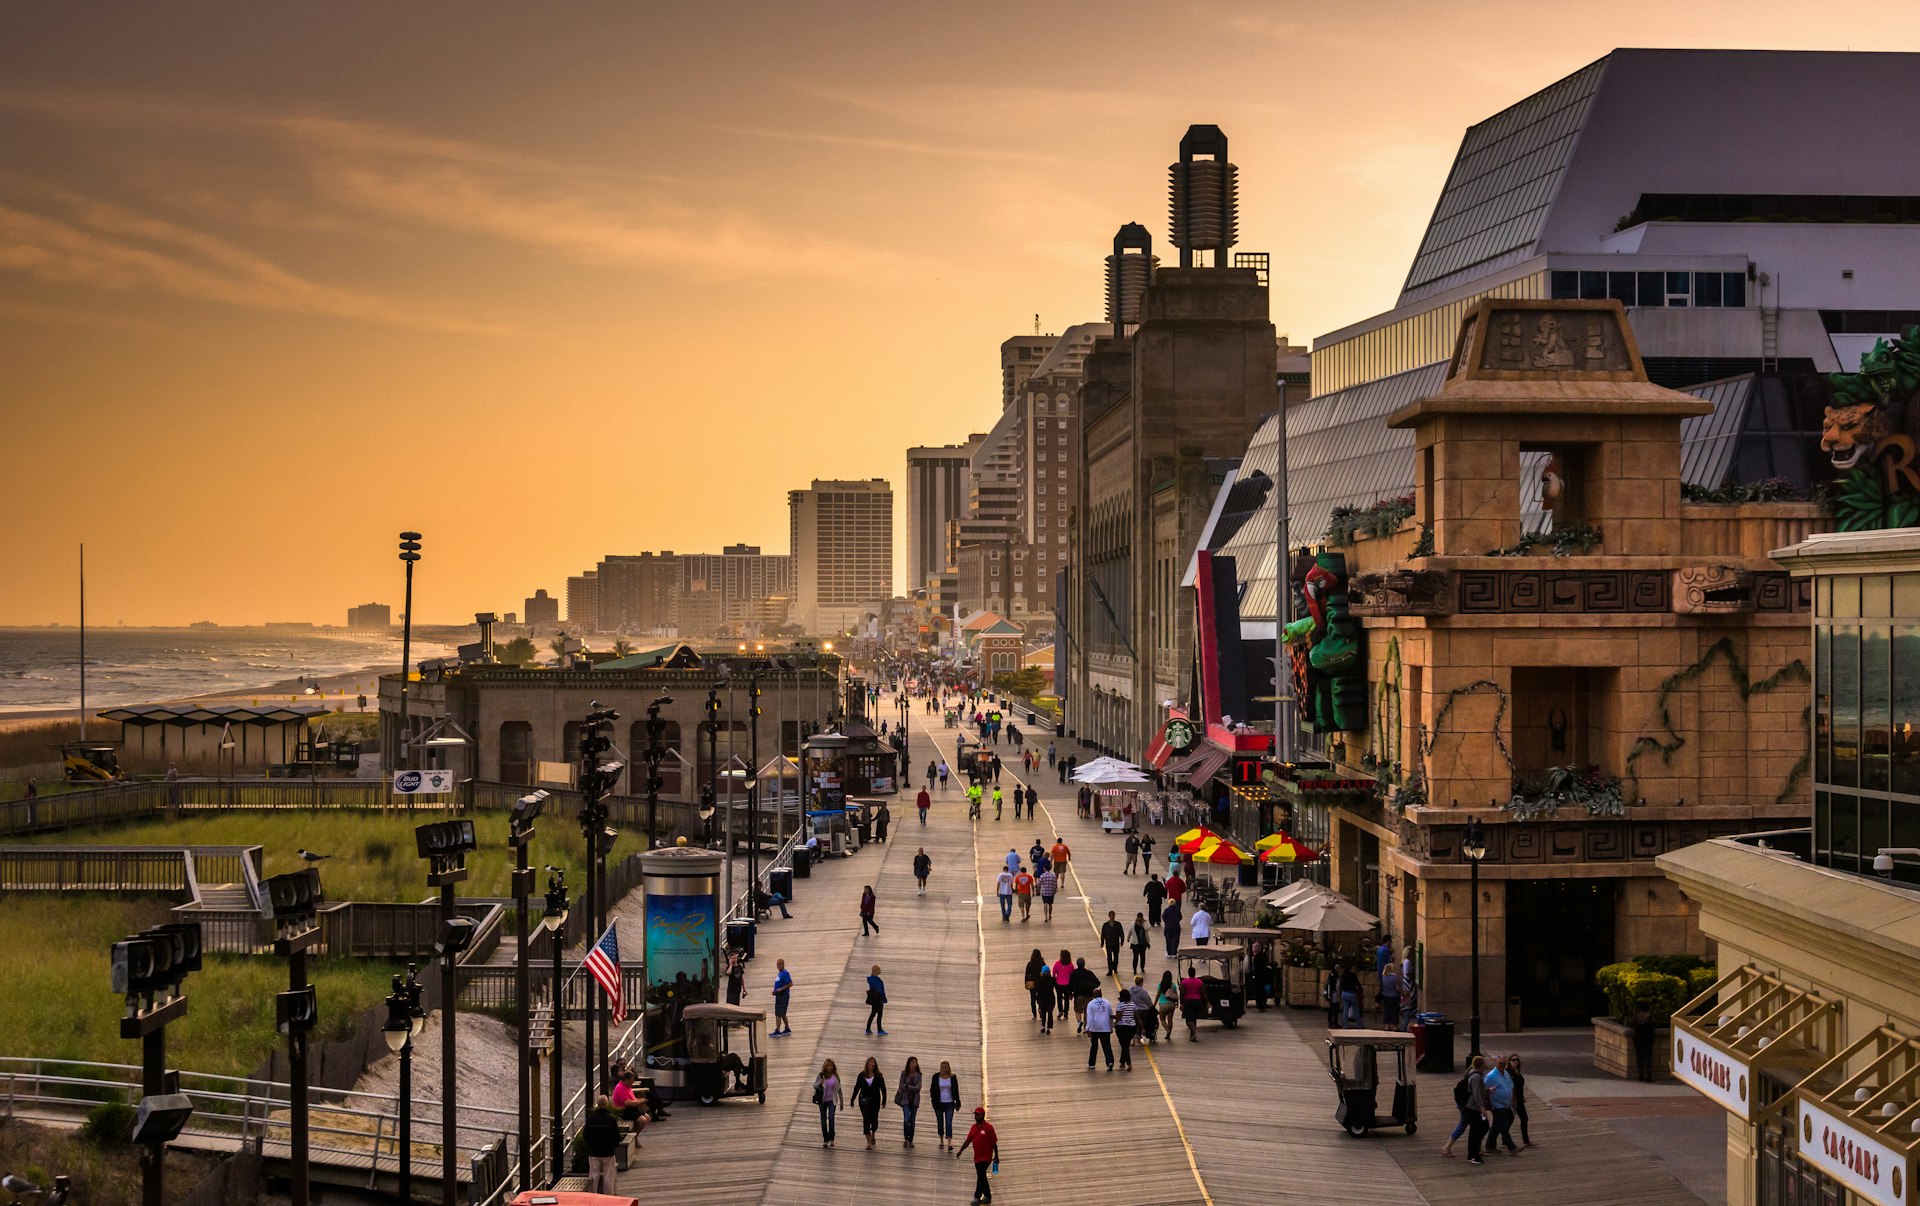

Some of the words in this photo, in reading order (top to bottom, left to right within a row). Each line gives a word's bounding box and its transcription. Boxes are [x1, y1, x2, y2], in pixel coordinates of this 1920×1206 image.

[1299, 779, 1336, 790] TRUMP
[1690, 1047, 1730, 1093] CAESARS
[1822, 1125, 1879, 1185] CAESARS
